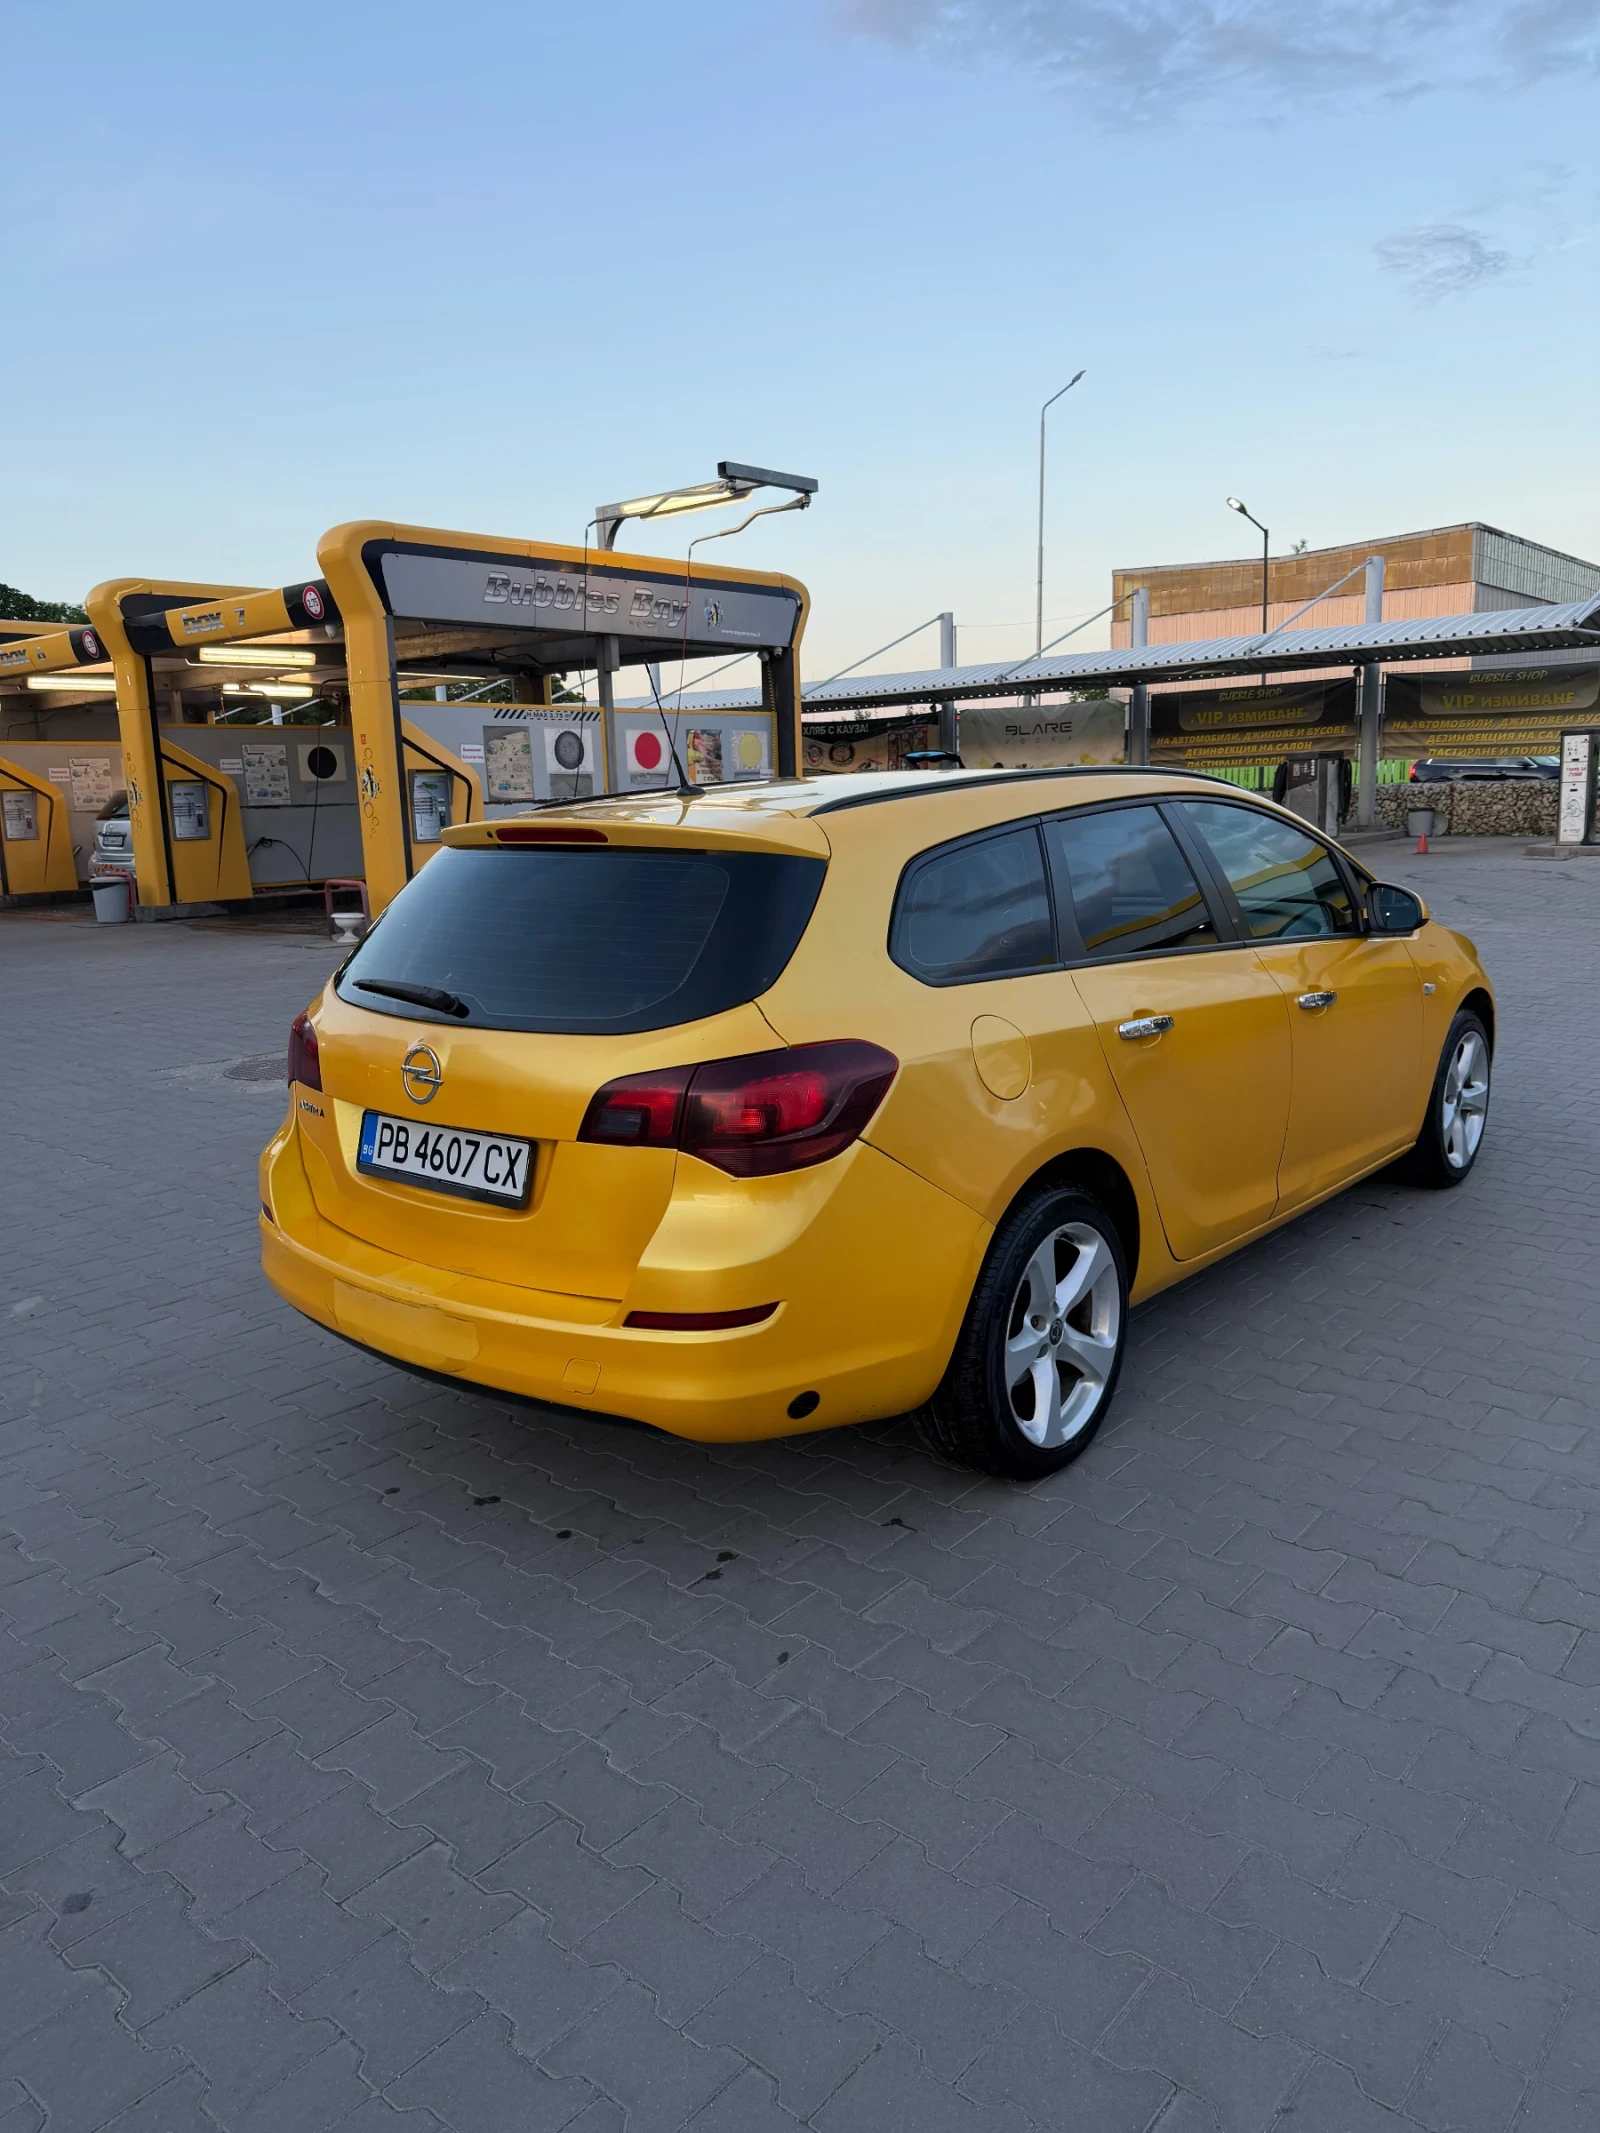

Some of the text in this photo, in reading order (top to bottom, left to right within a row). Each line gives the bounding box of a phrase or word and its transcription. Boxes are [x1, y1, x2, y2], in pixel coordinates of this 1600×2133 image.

[482, 570, 691, 628] Bubbles Bay
[181, 606, 245, 635] box 7
[1468, 669, 1549, 684] BUBBLE SHOP
[1219, 687, 1283, 701] BUBBLE SHOP
[1442, 692, 1575, 709] VIP ИЗМИВАНЕ
[1196, 707, 1304, 725] VIP ИЗМИВАНЕ
[1392, 720, 1408, 730] НА
[1499, 714, 1562, 728] ДЖИПОВЕ
[1563, 714, 1574, 723] И
[802, 725, 826, 736] ХЛЯБ
[836, 723, 869, 734] КАУЗА!
[1005, 721, 1073, 736] BLARE
[1156, 736, 1169, 746] НА
[1243, 729, 1295, 742] ДЖИПОВЕ
[1296, 728, 1305, 736] И
[1306, 725, 1347, 736] БУСОВЕ
[1426, 731, 1514, 746] ДЕЗИНФЕКЦИЯ
[1517, 731, 1535, 741] НА
[1185, 741, 1313, 760] ДЕЗИНФЕКЦИЯ НА САЛОН
[1428, 746, 1498, 758] ПАСТИРАНЕ
[1499, 746, 1510, 756] И
[1187, 756, 1287, 769] ПАСТИРАНЕ И ПОЛИ
[362, 1144, 374, 1156] BG
[377, 1122, 523, 1189] PB 4607 CX
